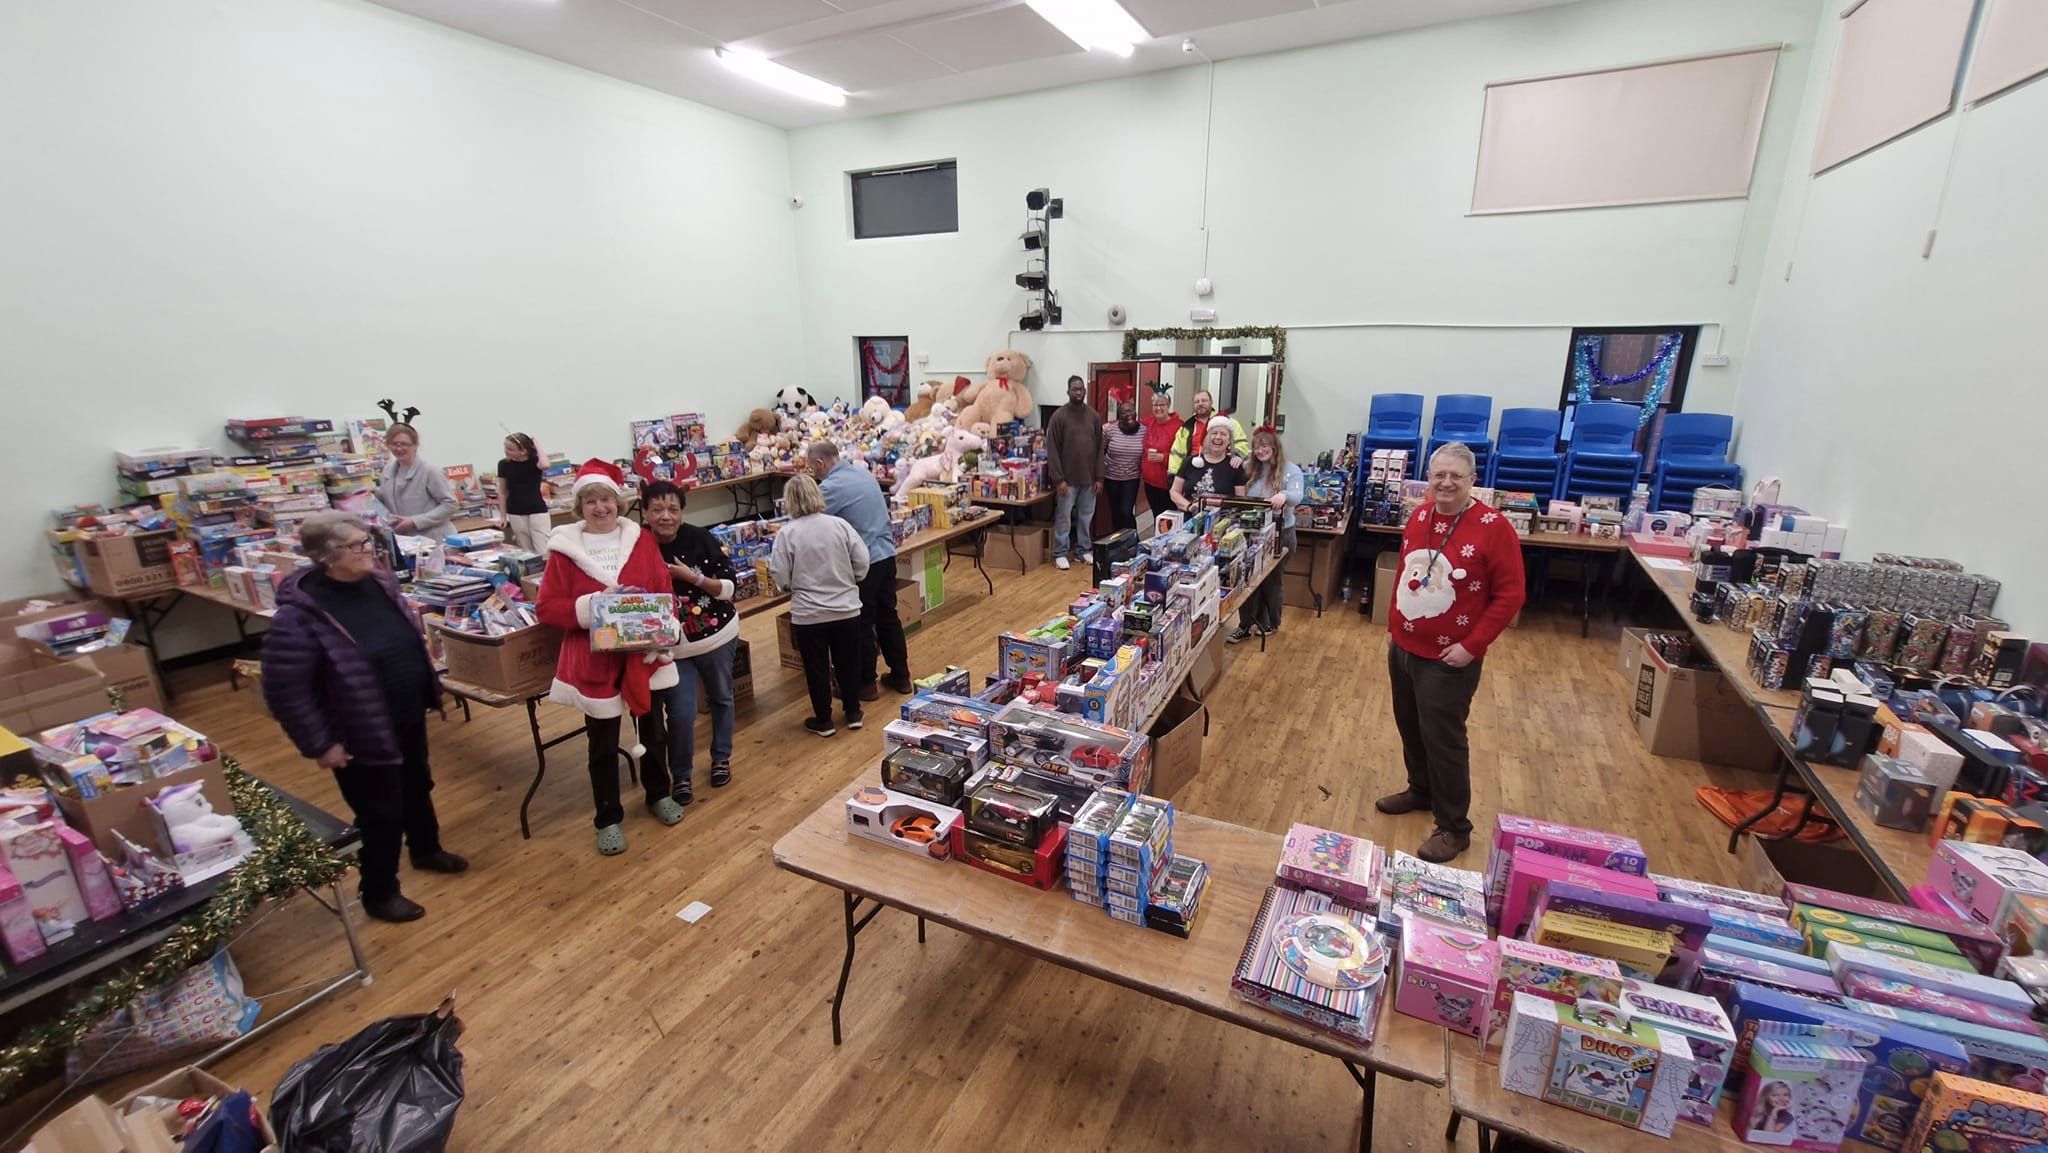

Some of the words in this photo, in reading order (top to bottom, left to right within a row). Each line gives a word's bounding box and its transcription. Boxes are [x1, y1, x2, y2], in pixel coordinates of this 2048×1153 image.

[1515, 837, 1545, 850] POP
[1623, 856, 1638, 866] 10
[1581, 1034, 1636, 1062] DINO
[1969, 1099, 2046, 1127] ROCK
